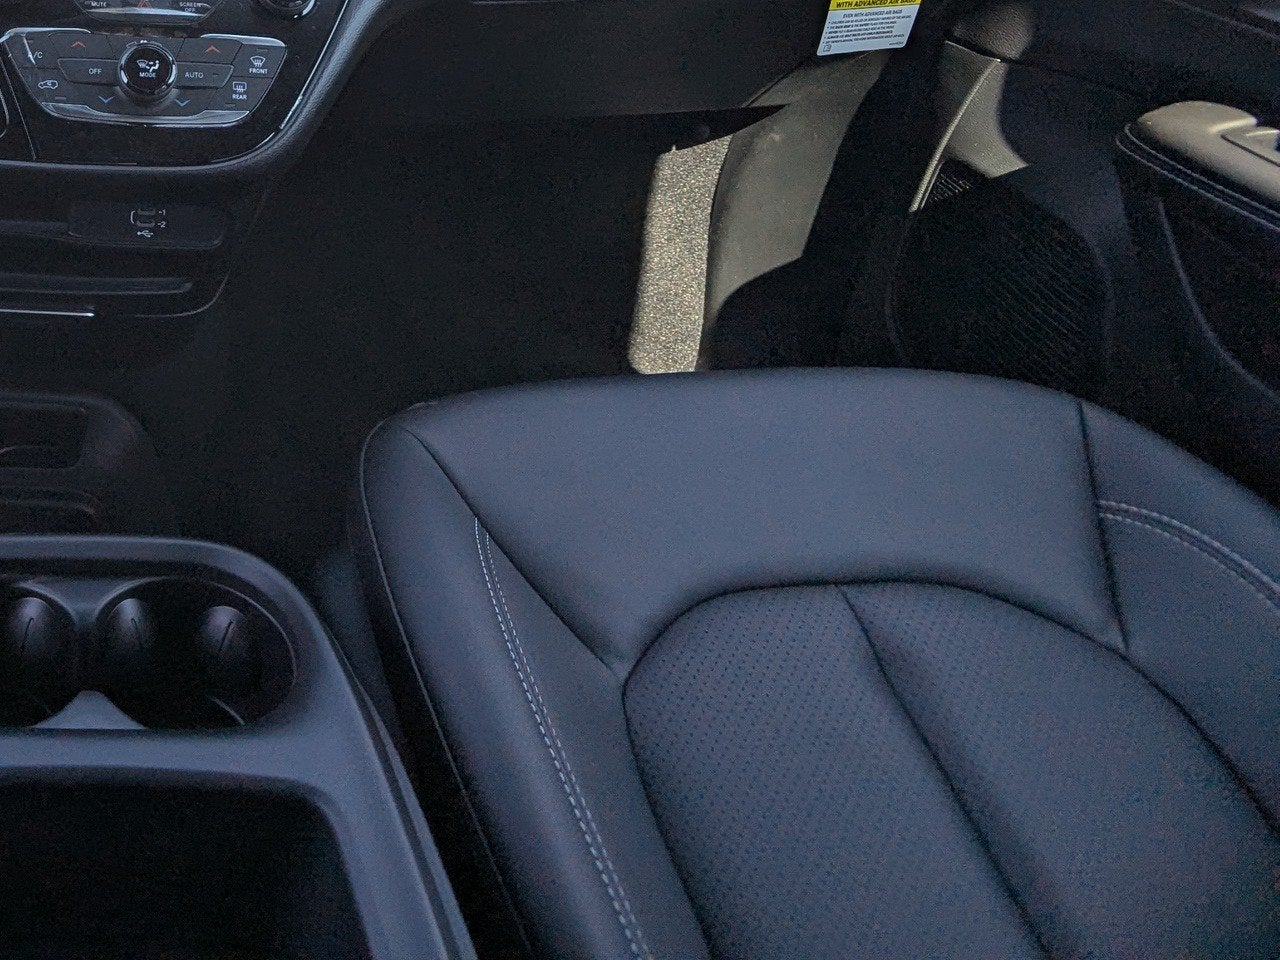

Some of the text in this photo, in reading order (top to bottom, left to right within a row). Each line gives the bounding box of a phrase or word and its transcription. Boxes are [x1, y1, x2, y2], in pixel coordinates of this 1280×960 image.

[853, 0, 888, 8] ADVANCED
[88, 67, 102, 75] OFF
[184, 71, 204, 79] AUTO
[248, 67, 268, 75] FRONT
